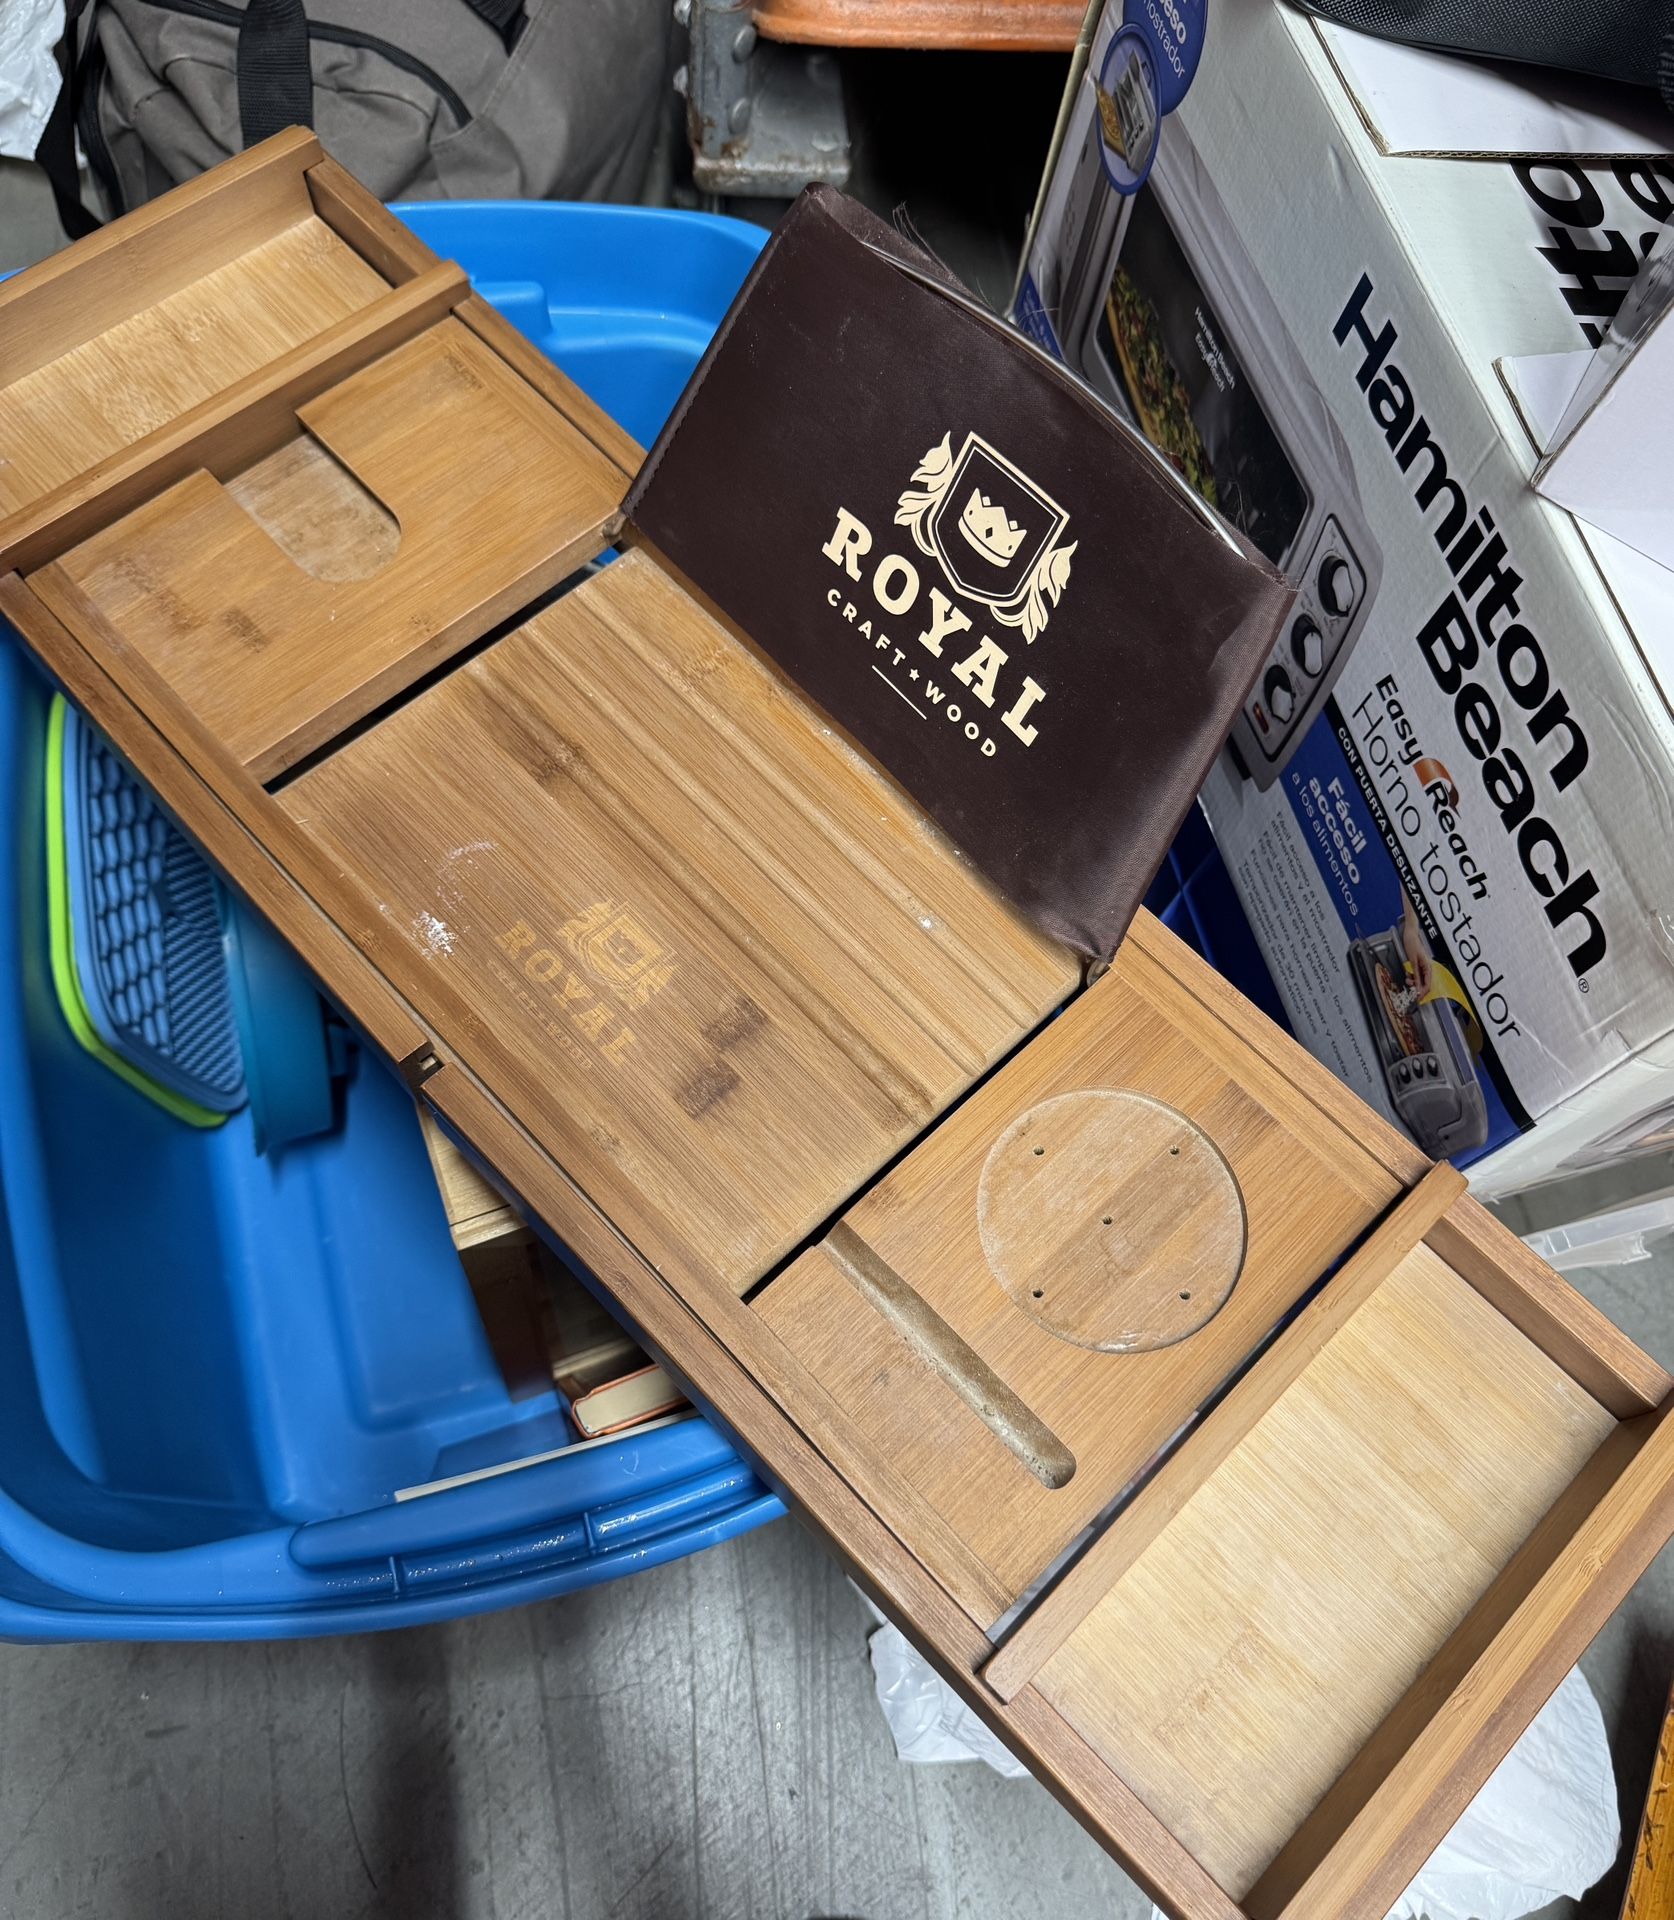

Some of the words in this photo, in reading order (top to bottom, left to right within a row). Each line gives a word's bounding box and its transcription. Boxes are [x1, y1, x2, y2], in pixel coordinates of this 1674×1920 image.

[822, 507, 1047, 747] ROYAL
[1332, 272, 1590, 793] Hamilton
[827, 588, 906, 666] CRAFT
[925, 679, 997, 757] WOOD
[1292, 772, 1300, 785] a
[1299, 786, 1314, 818] los
[1312, 820, 1358, 917] alimentos
[1309, 777, 1360, 884] acceso
[1327, 776, 1367, 854] Fácil
[1338, 727, 1358, 764] CON
[1355, 766, 1388, 833] PUERTA
[1386, 833, 1438, 940] DESLIZANTE
[1352, 692, 1421, 837] Horno
[1420, 841, 1520, 1039] tostador
[1376, 674, 1423, 766] Easy
[1425, 781, 1488, 900] Reach
[495, 918, 637, 1068] ROYAL
